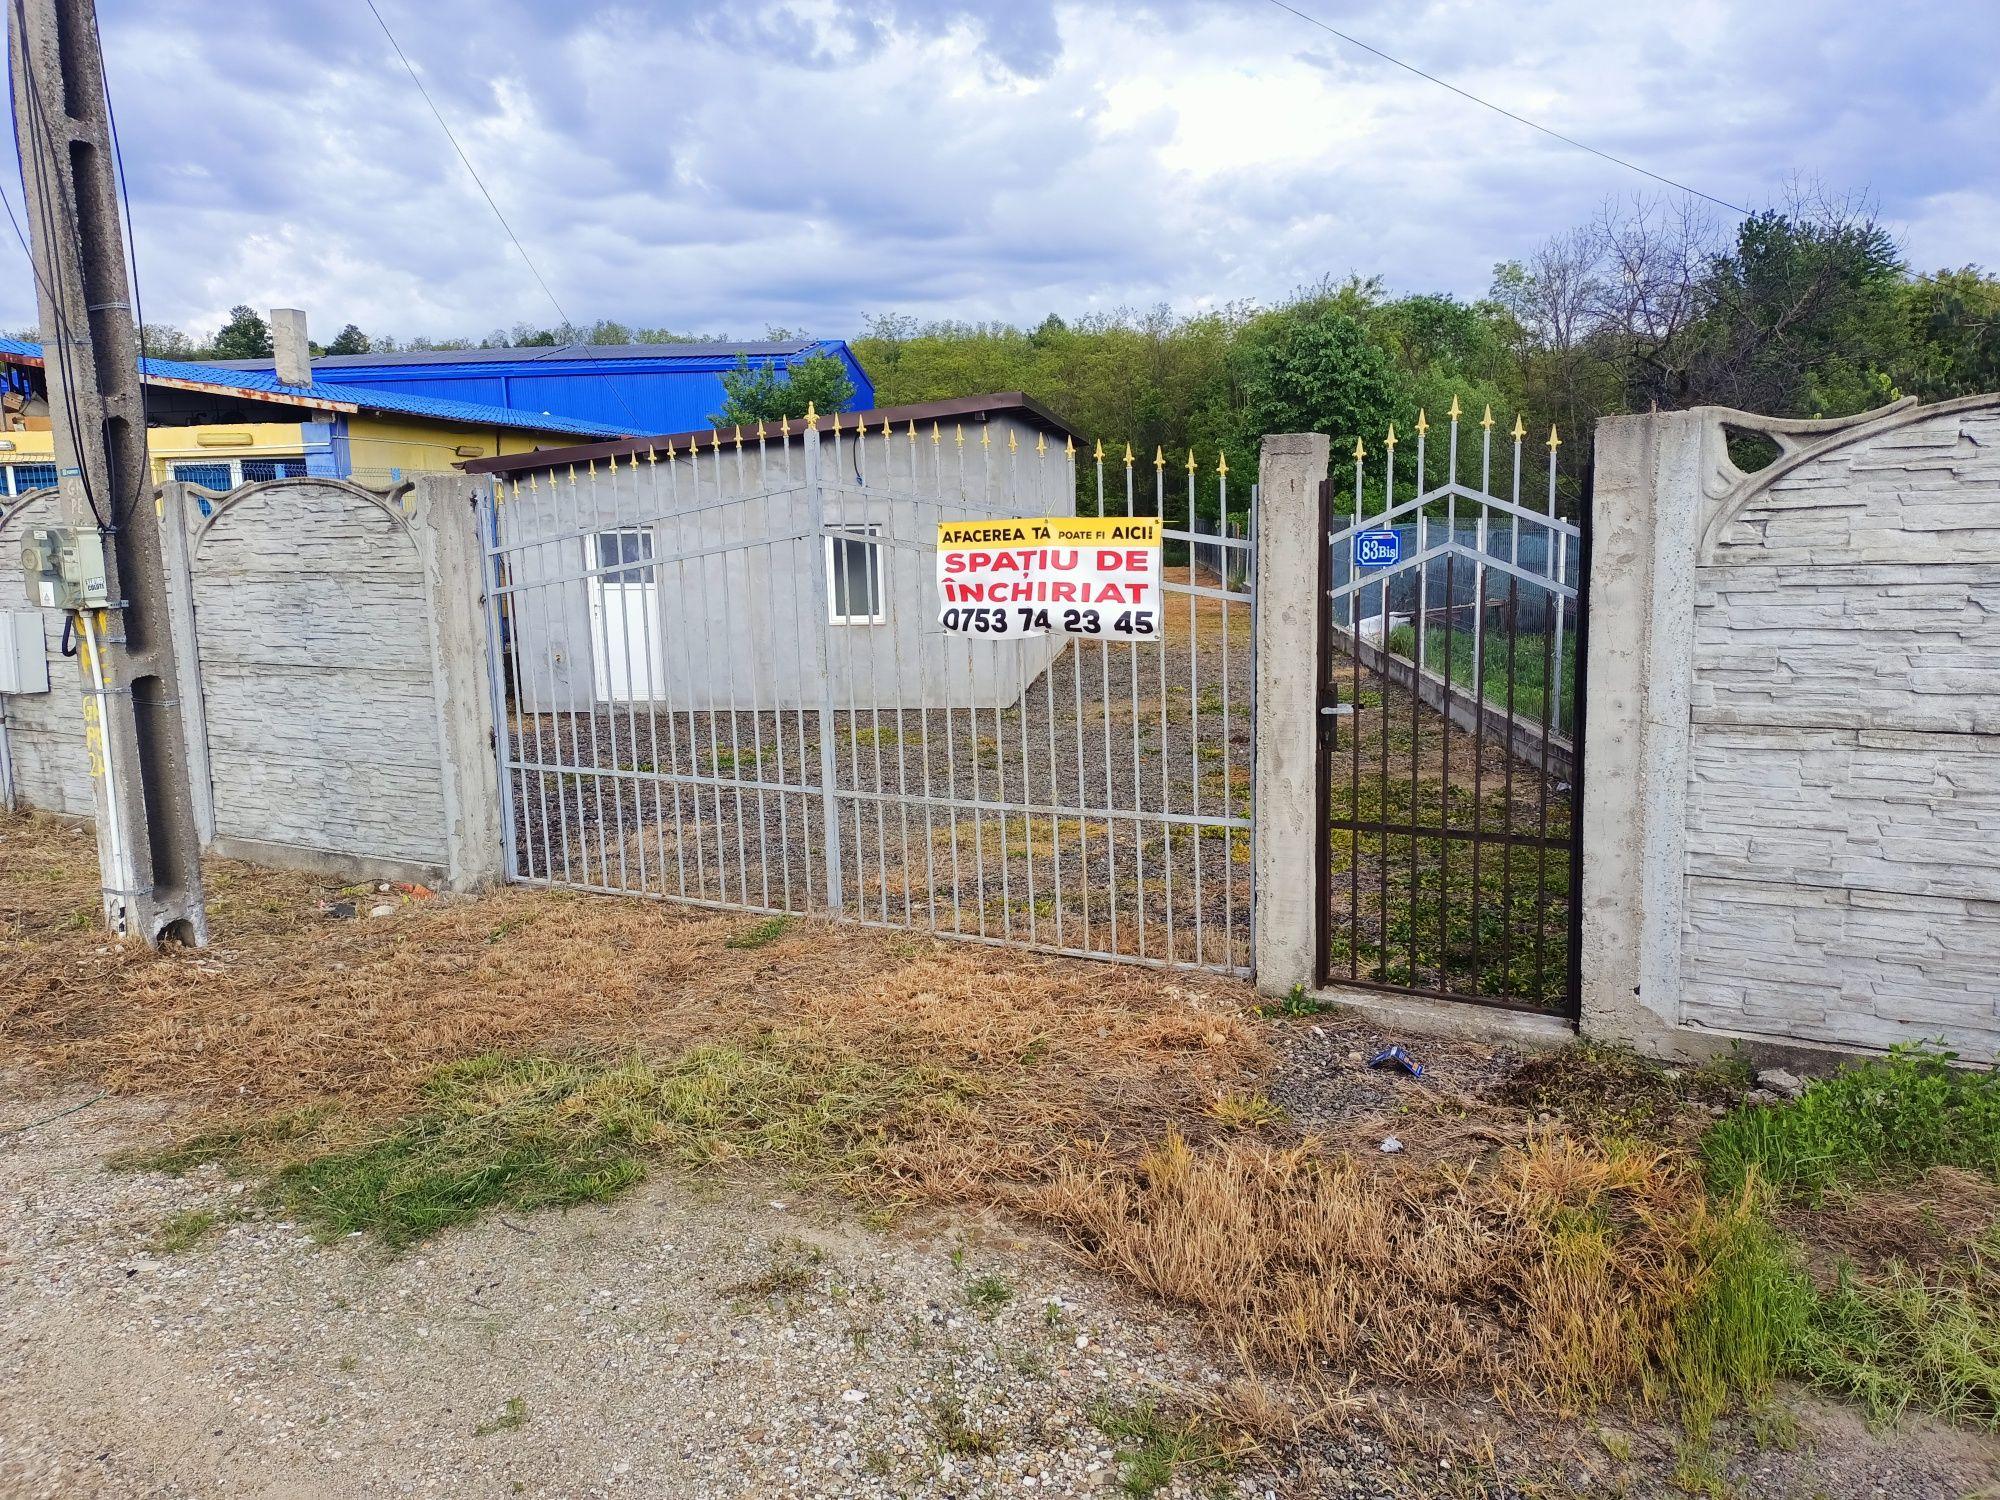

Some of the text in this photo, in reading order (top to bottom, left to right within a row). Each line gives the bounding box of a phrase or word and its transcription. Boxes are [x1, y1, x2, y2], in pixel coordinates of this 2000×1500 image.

[942, 526, 1153, 543] AFACEREA TA POATE FI AICI!
[944, 549, 1148, 579] SPAȚIU DE
[941, 577, 1149, 604] ÎNCHIRIAT
[942, 608, 1154, 634] 0753 74 23 45
